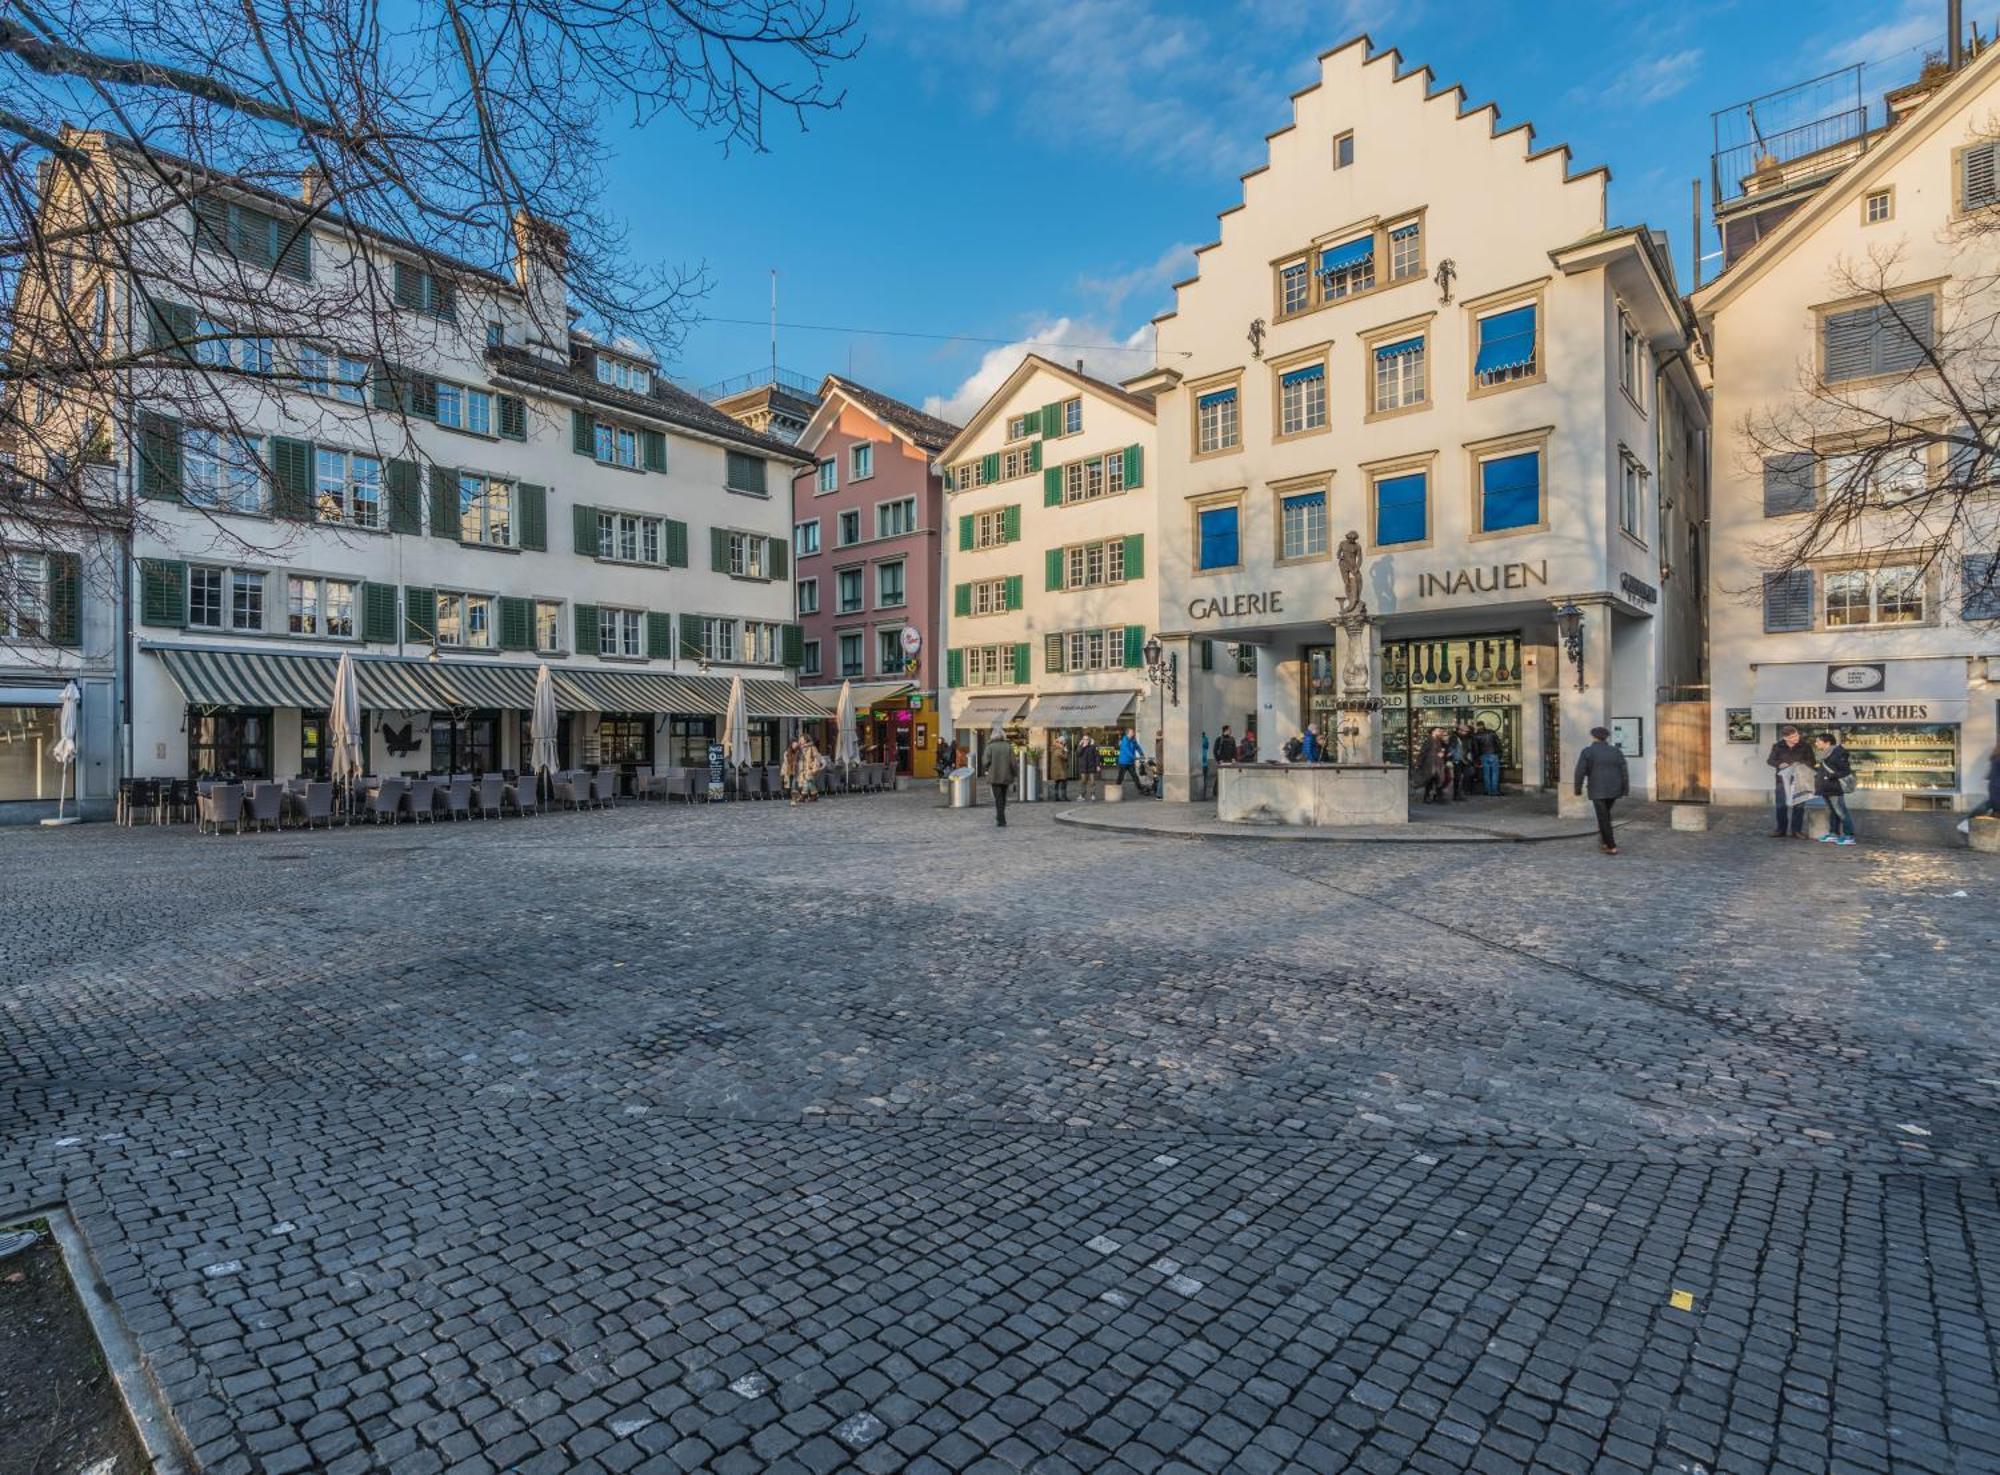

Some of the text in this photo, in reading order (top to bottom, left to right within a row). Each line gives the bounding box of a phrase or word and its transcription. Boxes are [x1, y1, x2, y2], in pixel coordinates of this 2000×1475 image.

[1188, 559, 1548, 619] GALERIE INAUEN
[1422, 694, 1459, 705] SILBER
[1467, 693, 1511, 704] UHREN
[1785, 706, 1837, 720] UHREN
[1852, 705, 1929, 720] WATCHES
